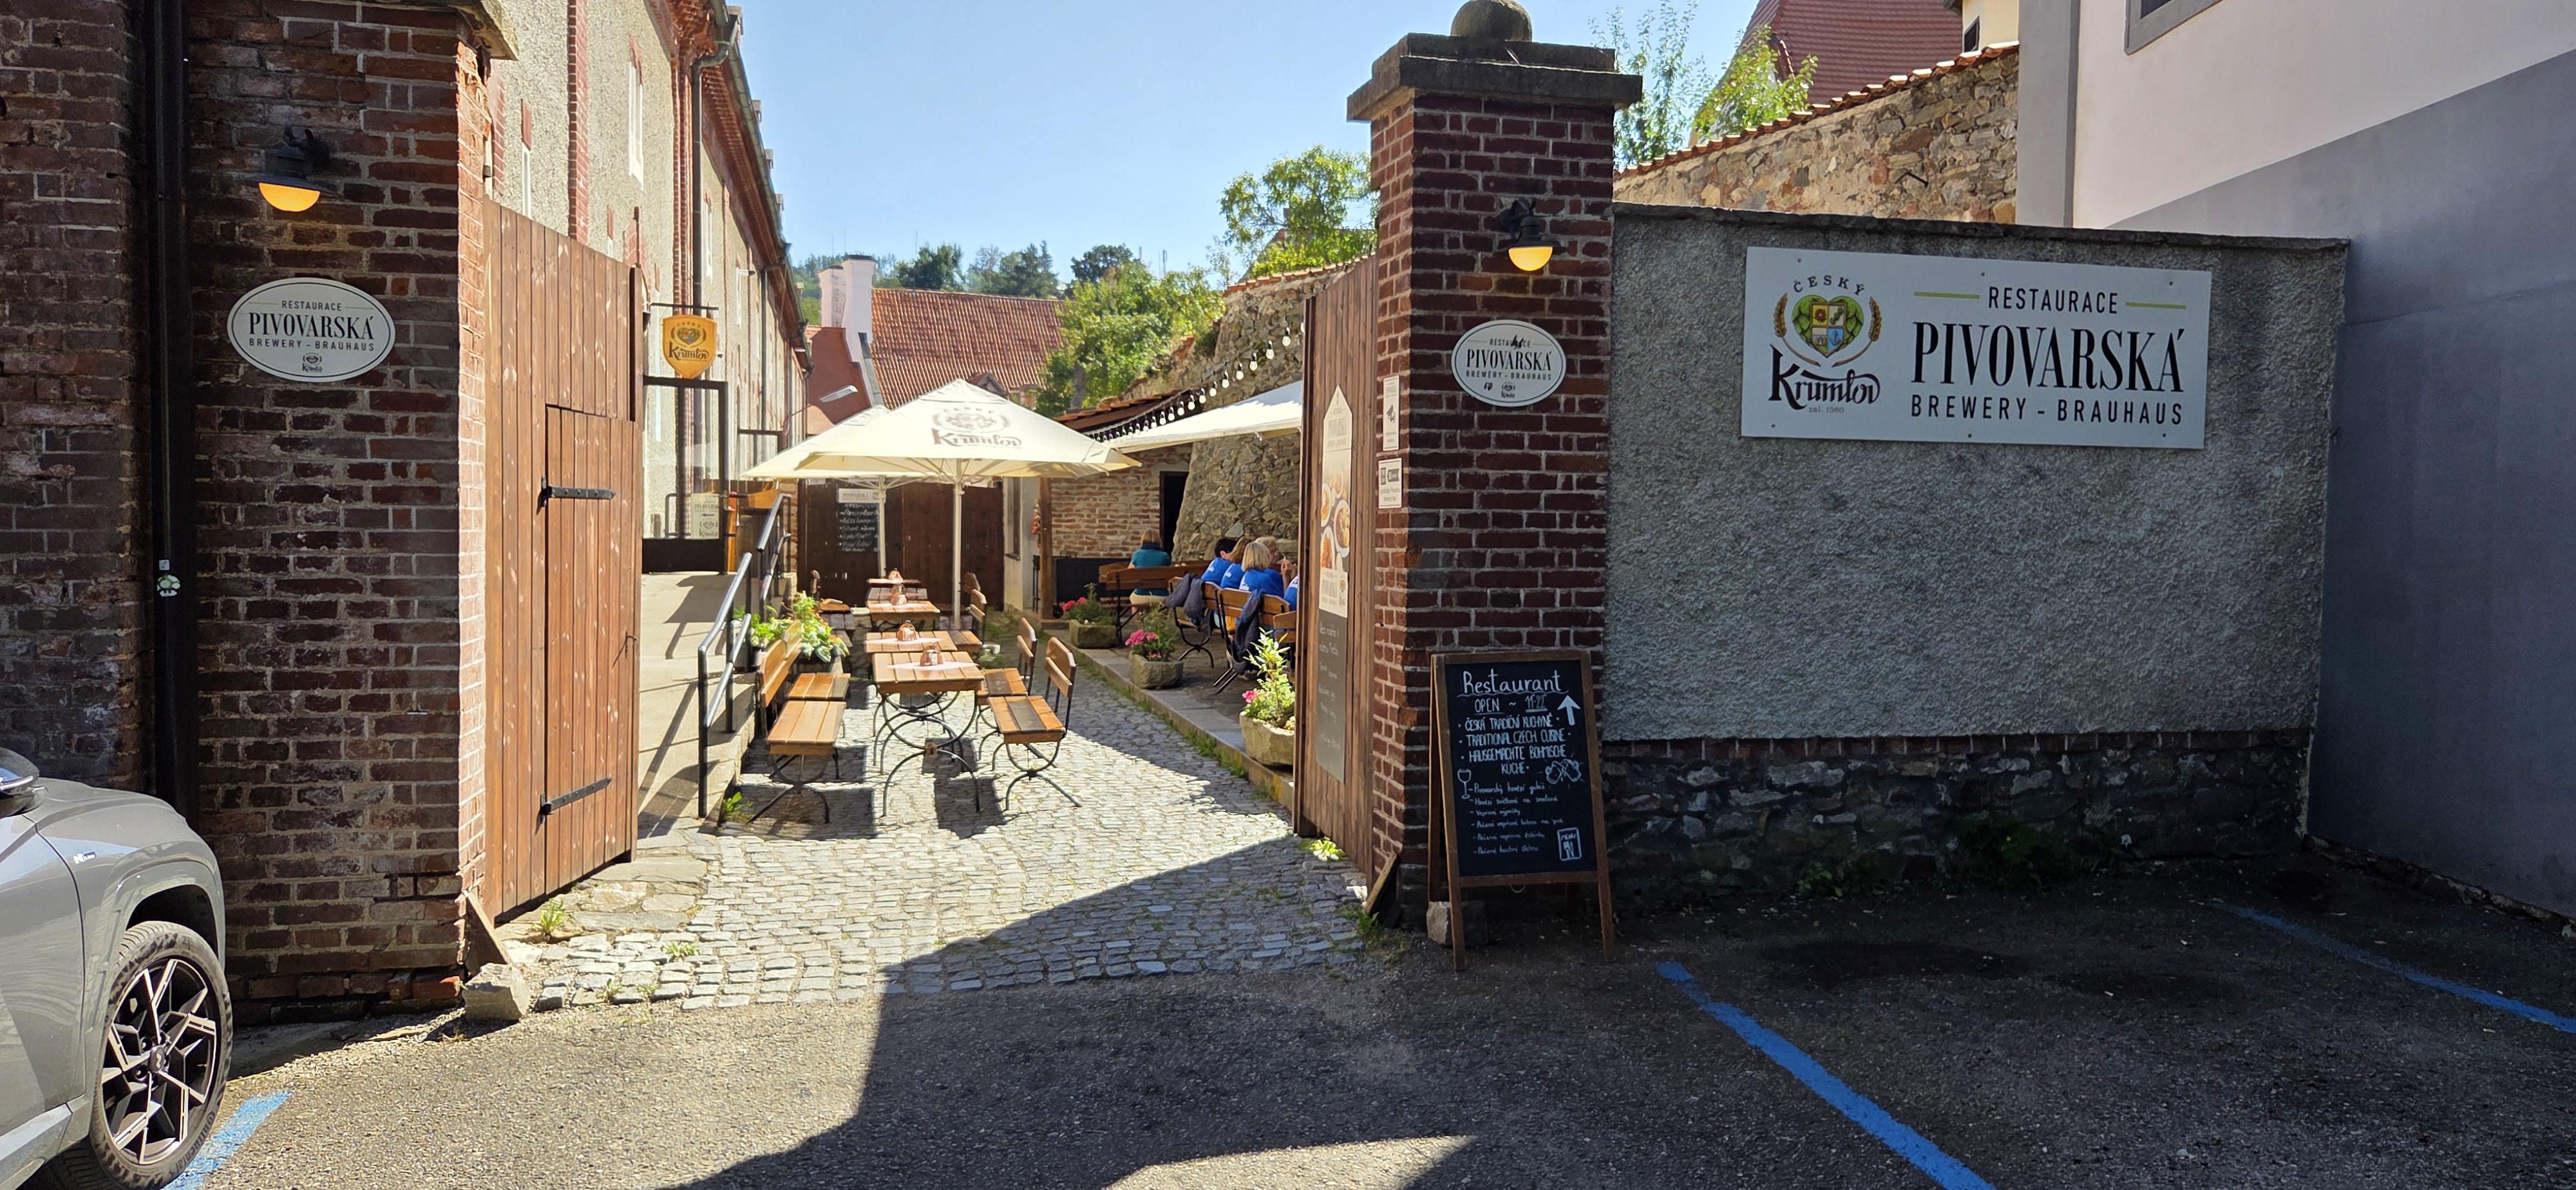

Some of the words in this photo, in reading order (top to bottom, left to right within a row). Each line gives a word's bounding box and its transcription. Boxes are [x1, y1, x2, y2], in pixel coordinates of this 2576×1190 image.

[1794, 274, 1865, 296] ČESKÝ
[281, 300, 342, 311] RESTAURACE
[1988, 287, 2119, 314] RESTAURACE
[249, 312, 374, 339] PIVOVARSKÁ
[249, 338, 302, 348] BREWERY
[316, 340, 374, 351] BRAUHAUS
[1489, 338, 1531, 348] RESTACE
[1466, 348, 1552, 371] PIVOVARSKÁ
[1909, 321, 2186, 393] PIVOVARSKÁ
[1466, 370, 1502, 379] BREWERY
[1510, 372, 1551, 381] BRAUHAUS
[1768, 343, 1880, 410] Krumlov
[1911, 394, 2027, 421] BREWERY
[2058, 397, 2183, 426] BRAUHAUS
[931, 428, 1022, 447] Krumlov
[1463, 668, 1562, 694] Restaurant
[1475, 697, 1500, 713] OPEN
[1464, 717, 1486, 732] ČESKÁ
[1466, 732, 1513, 746] TRADITIONAL
[1513, 730, 1538, 744] CZECH
[1501, 760, 1526, 775] KÜCHE
